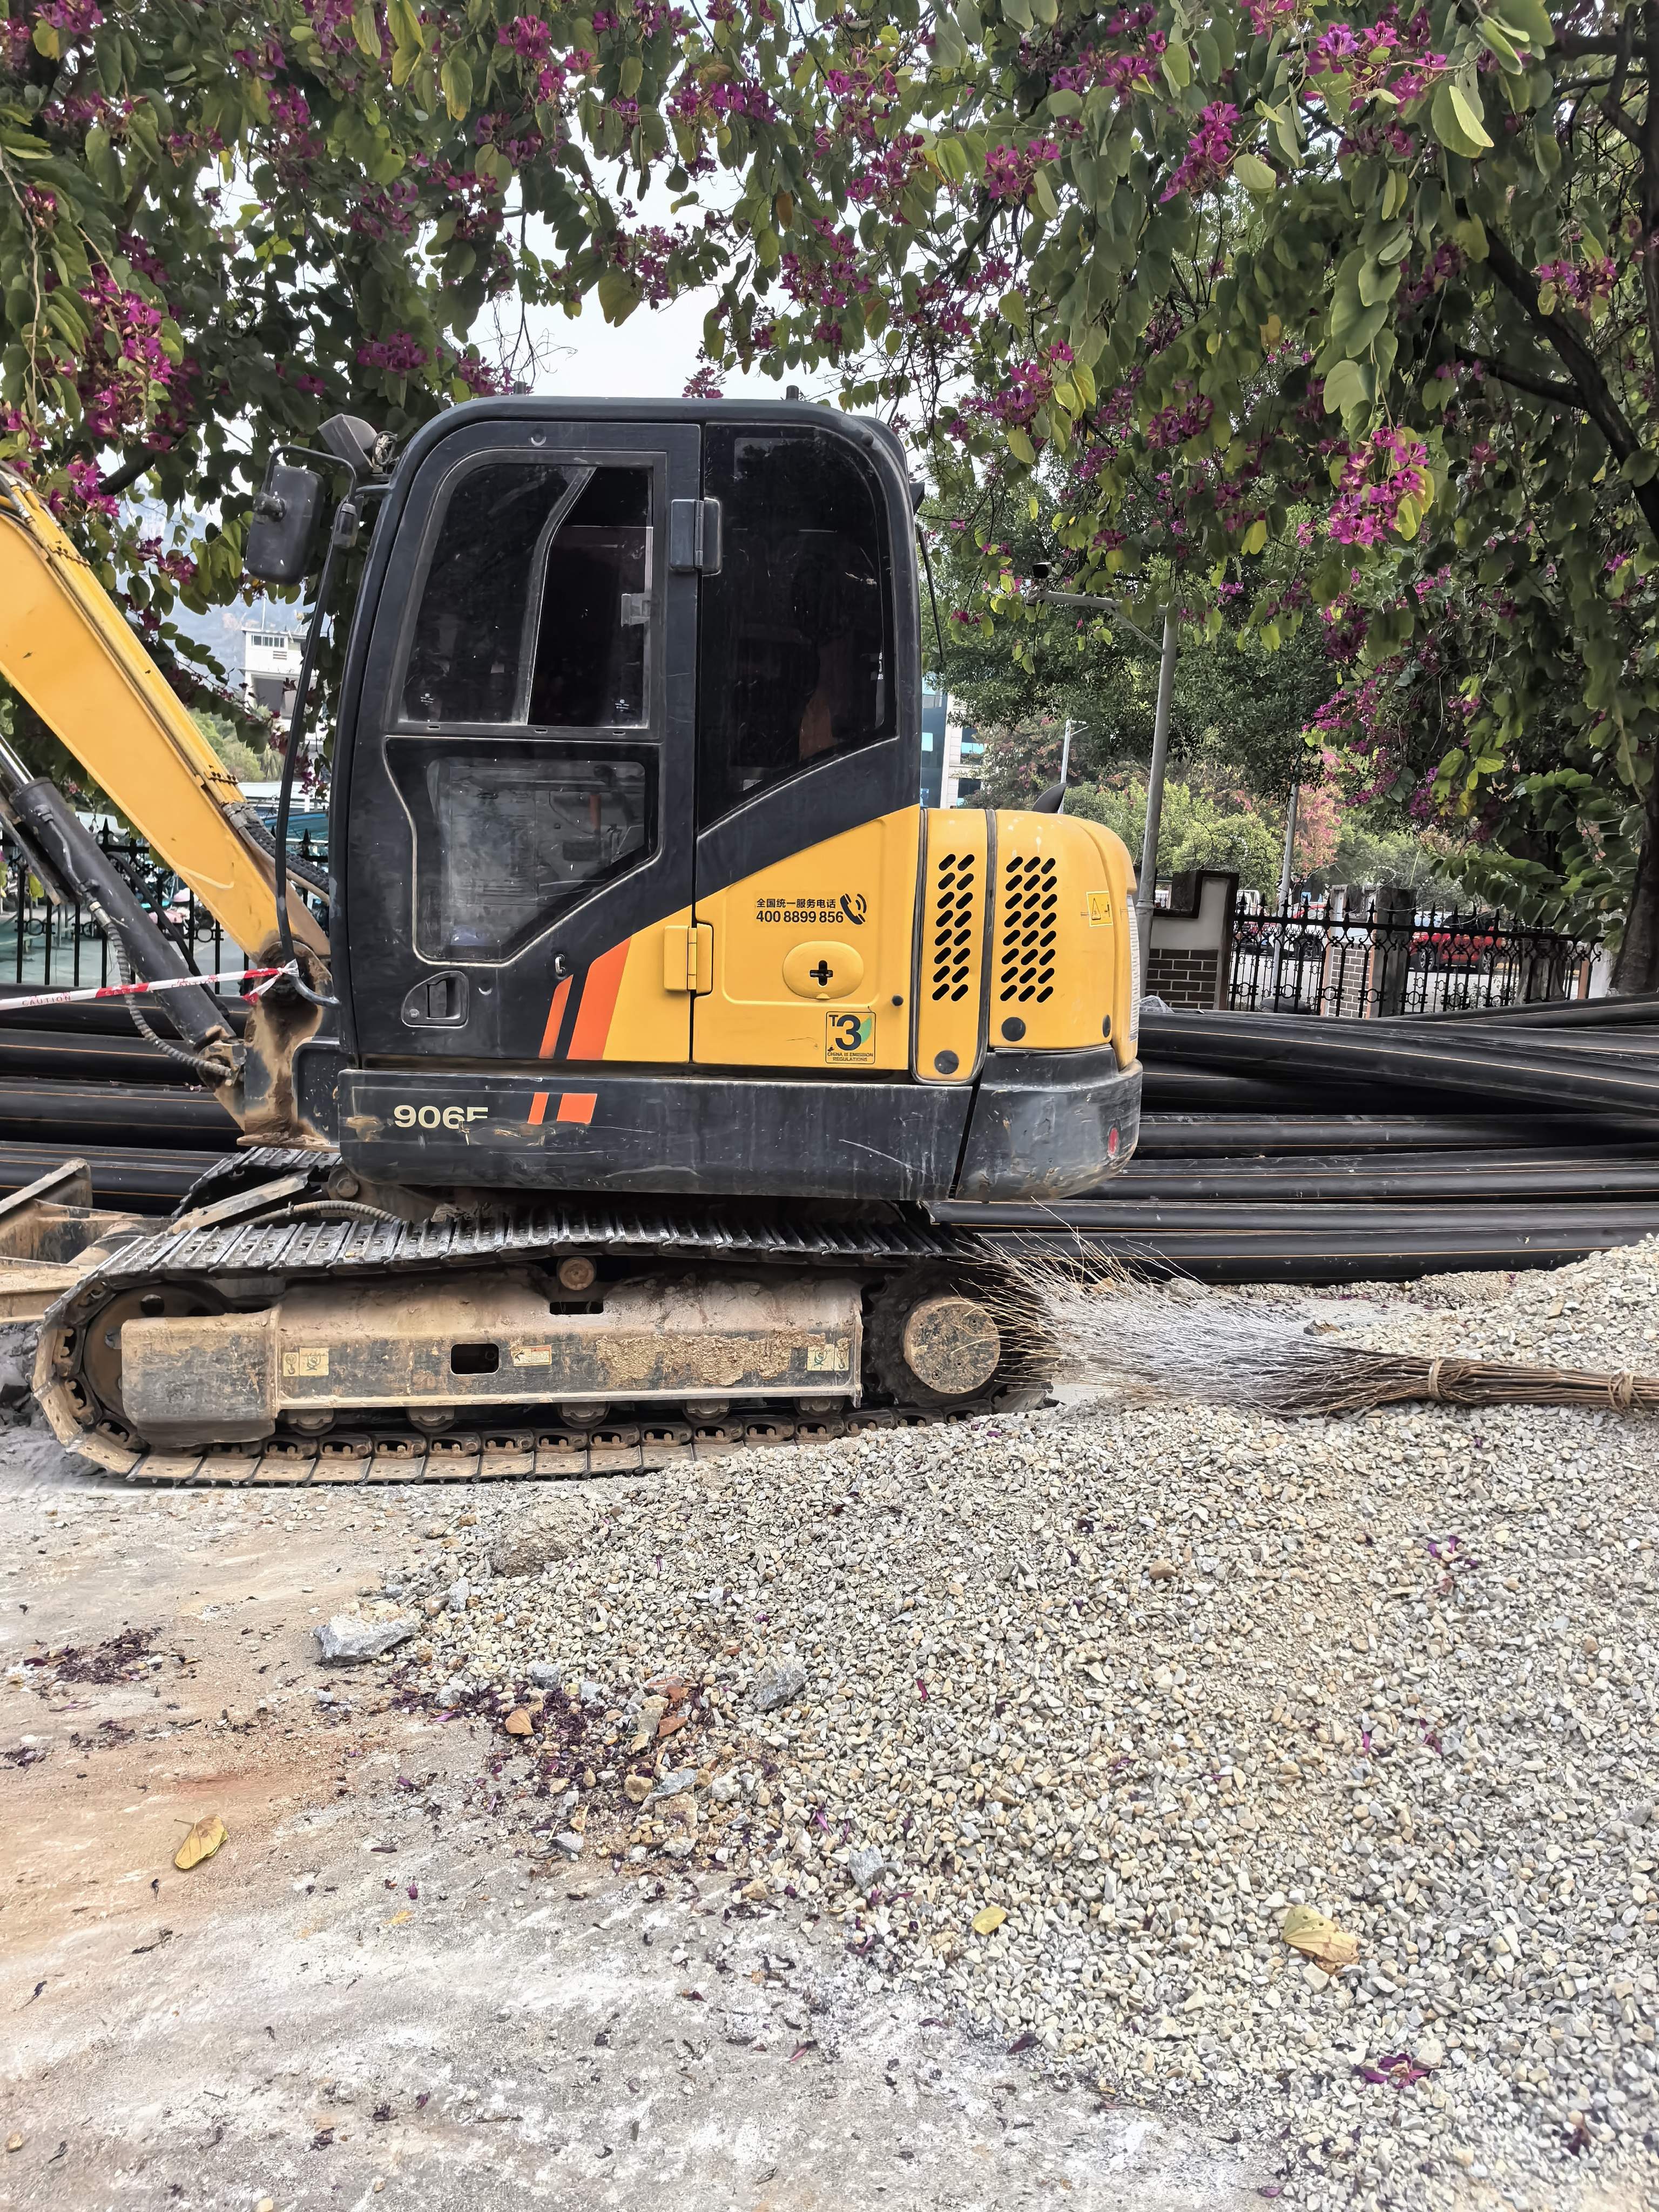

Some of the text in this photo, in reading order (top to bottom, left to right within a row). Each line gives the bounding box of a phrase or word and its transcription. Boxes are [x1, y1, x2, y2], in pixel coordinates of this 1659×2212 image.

[756, 898, 836, 908] 全国统一服务电话
[756, 911, 844, 923] 400 8899 856
[22, 995, 71, 1006] CAUTION
